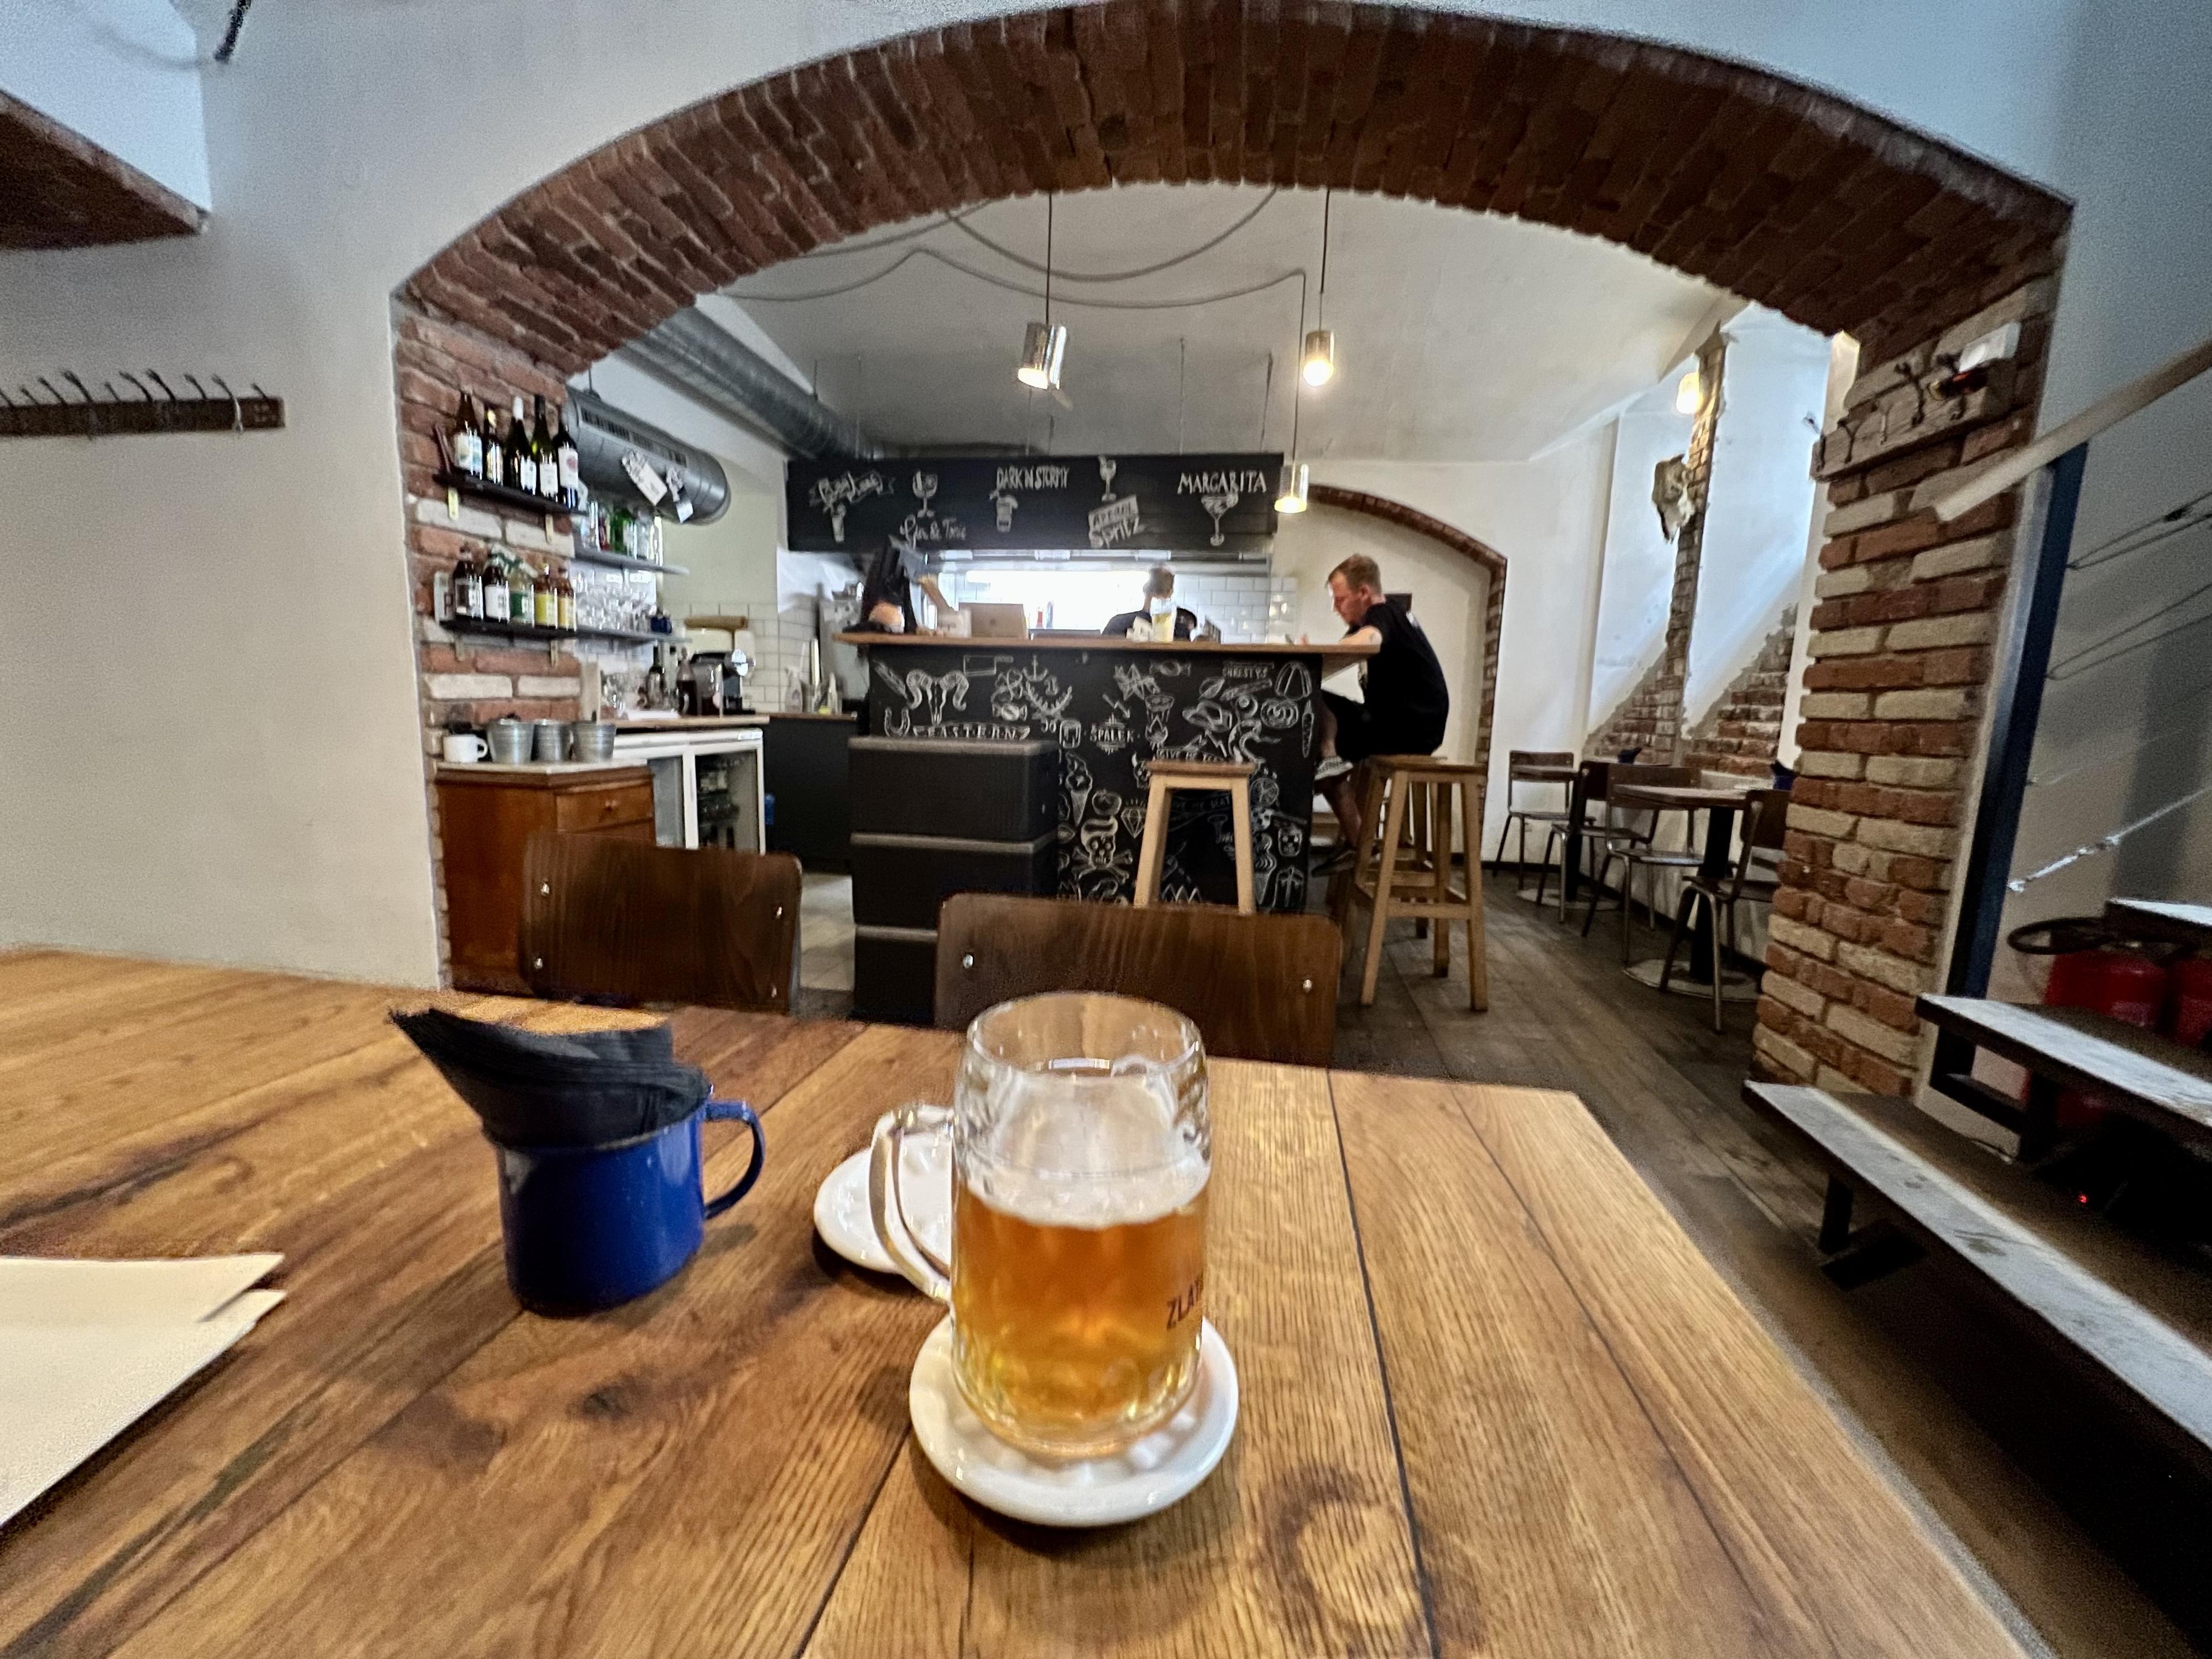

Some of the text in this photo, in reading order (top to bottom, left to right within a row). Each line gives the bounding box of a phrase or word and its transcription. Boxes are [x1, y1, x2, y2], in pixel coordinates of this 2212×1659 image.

[996, 466, 1022, 490] DARK
[1035, 465, 1070, 490] STORMY
[1177, 471, 1267, 494] MARGARITA
